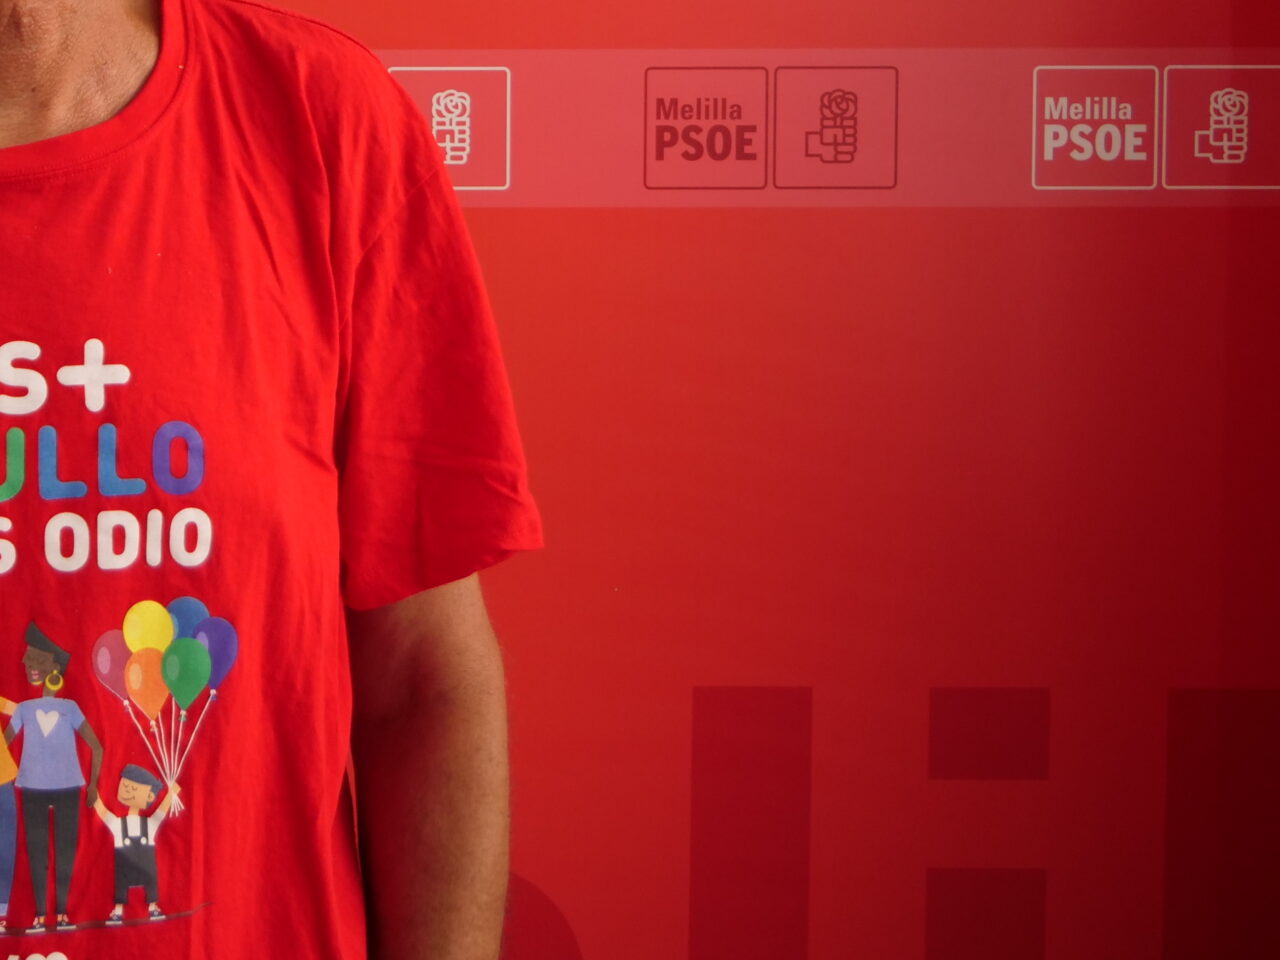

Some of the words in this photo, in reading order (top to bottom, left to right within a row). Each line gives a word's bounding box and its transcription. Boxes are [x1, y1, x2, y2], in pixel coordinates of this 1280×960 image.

[655, 97, 742, 121] Melilla
[1043, 96, 1133, 121] Melilla
[655, 124, 758, 162] PSOE
[1043, 123, 1148, 162] PSOE
[43, 507, 213, 572] ODIO
